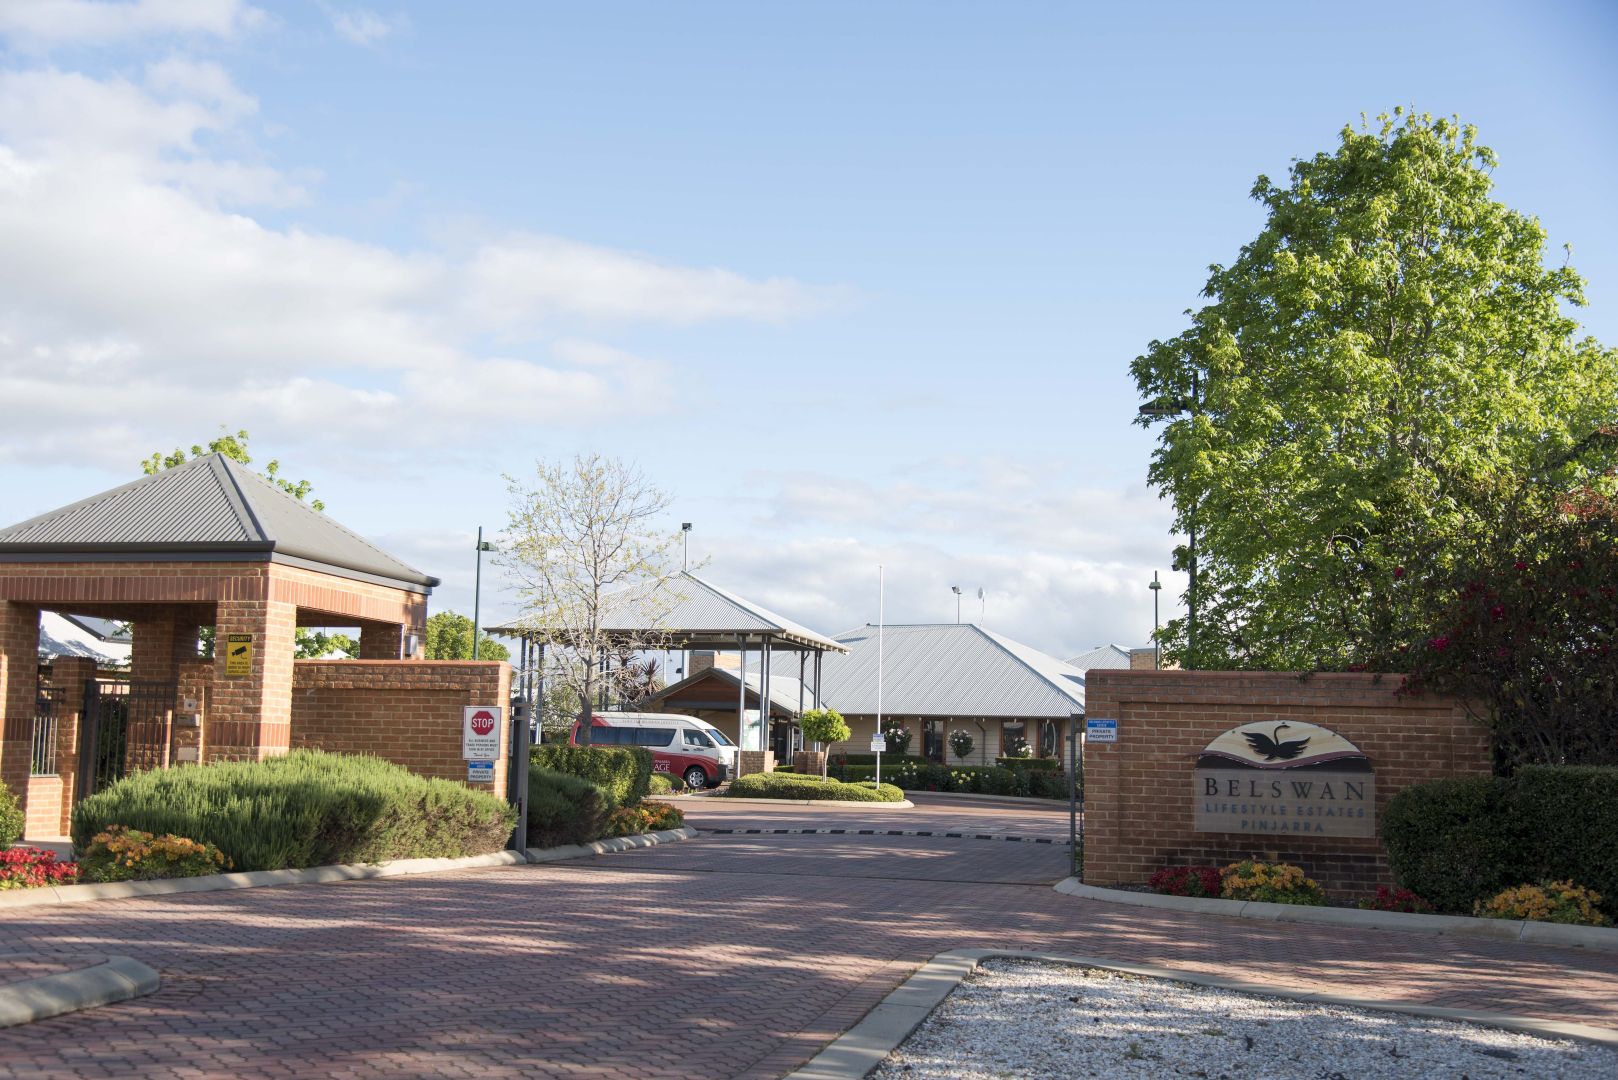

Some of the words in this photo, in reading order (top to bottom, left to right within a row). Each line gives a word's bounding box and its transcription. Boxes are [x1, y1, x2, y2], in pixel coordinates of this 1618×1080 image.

[472, 718, 494, 728] STOP
[1204, 777, 1364, 800] BELSWAN
[1205, 803, 1286, 816] LIFESTYLE
[1296, 806, 1365, 818] ESTATES
[1241, 820, 1324, 833] PINJARRA
